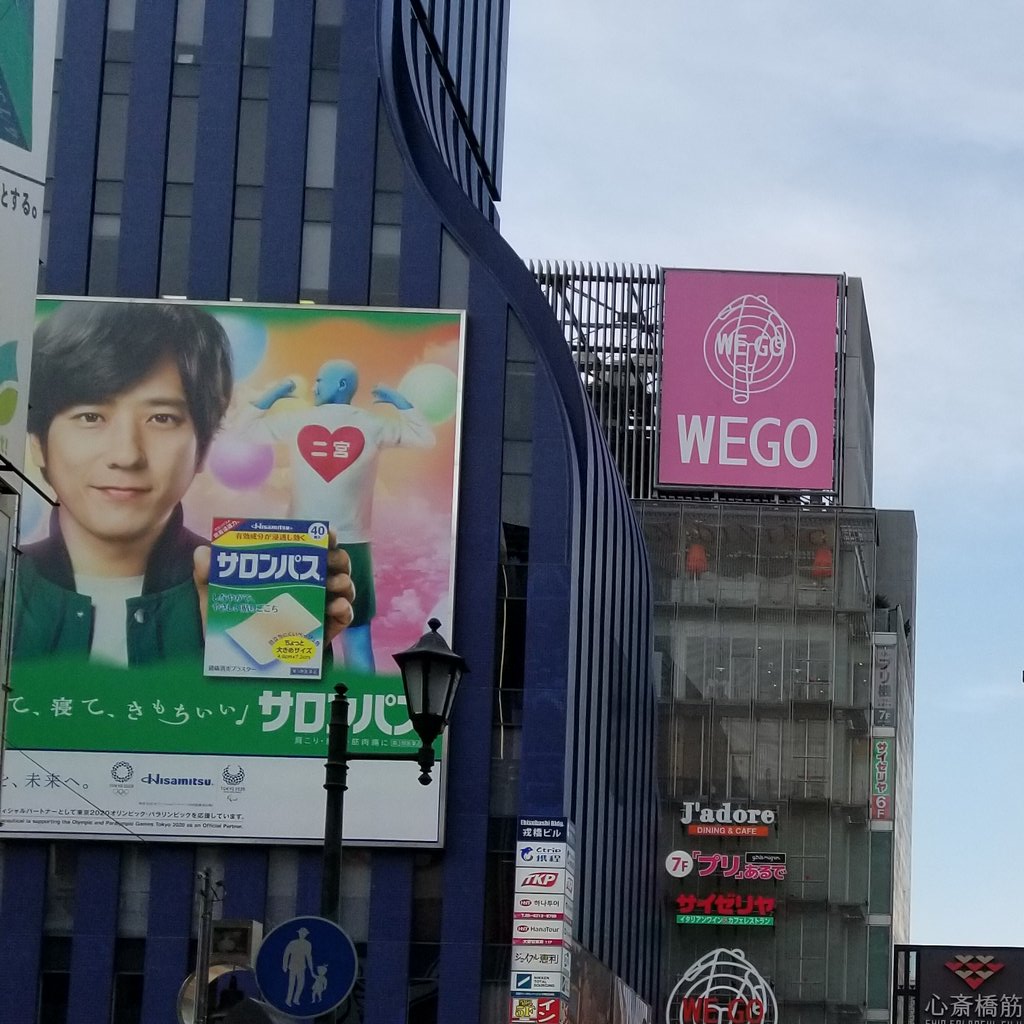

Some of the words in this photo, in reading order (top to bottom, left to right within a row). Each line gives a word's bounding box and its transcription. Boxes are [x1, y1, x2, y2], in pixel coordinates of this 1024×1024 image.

[311, 441, 350, 458] 二宮
[677, 414, 818, 469] WEGO
[310, 525, 325, 537] 40
[217, 551, 321, 581] サロンパス
[876, 741, 887, 793] サイゼリヤ
[141, 773, 212, 786] Hisamitsu
[680, 801, 776, 825] J'adore
[697, 827, 726, 835] DINING
[672, 857, 689, 872] 7F
[525, 874, 556, 885] TKP
[676, 894, 776, 915] サイゼリヤ
[924, 993, 1023, 1018] 心斎橋筋
